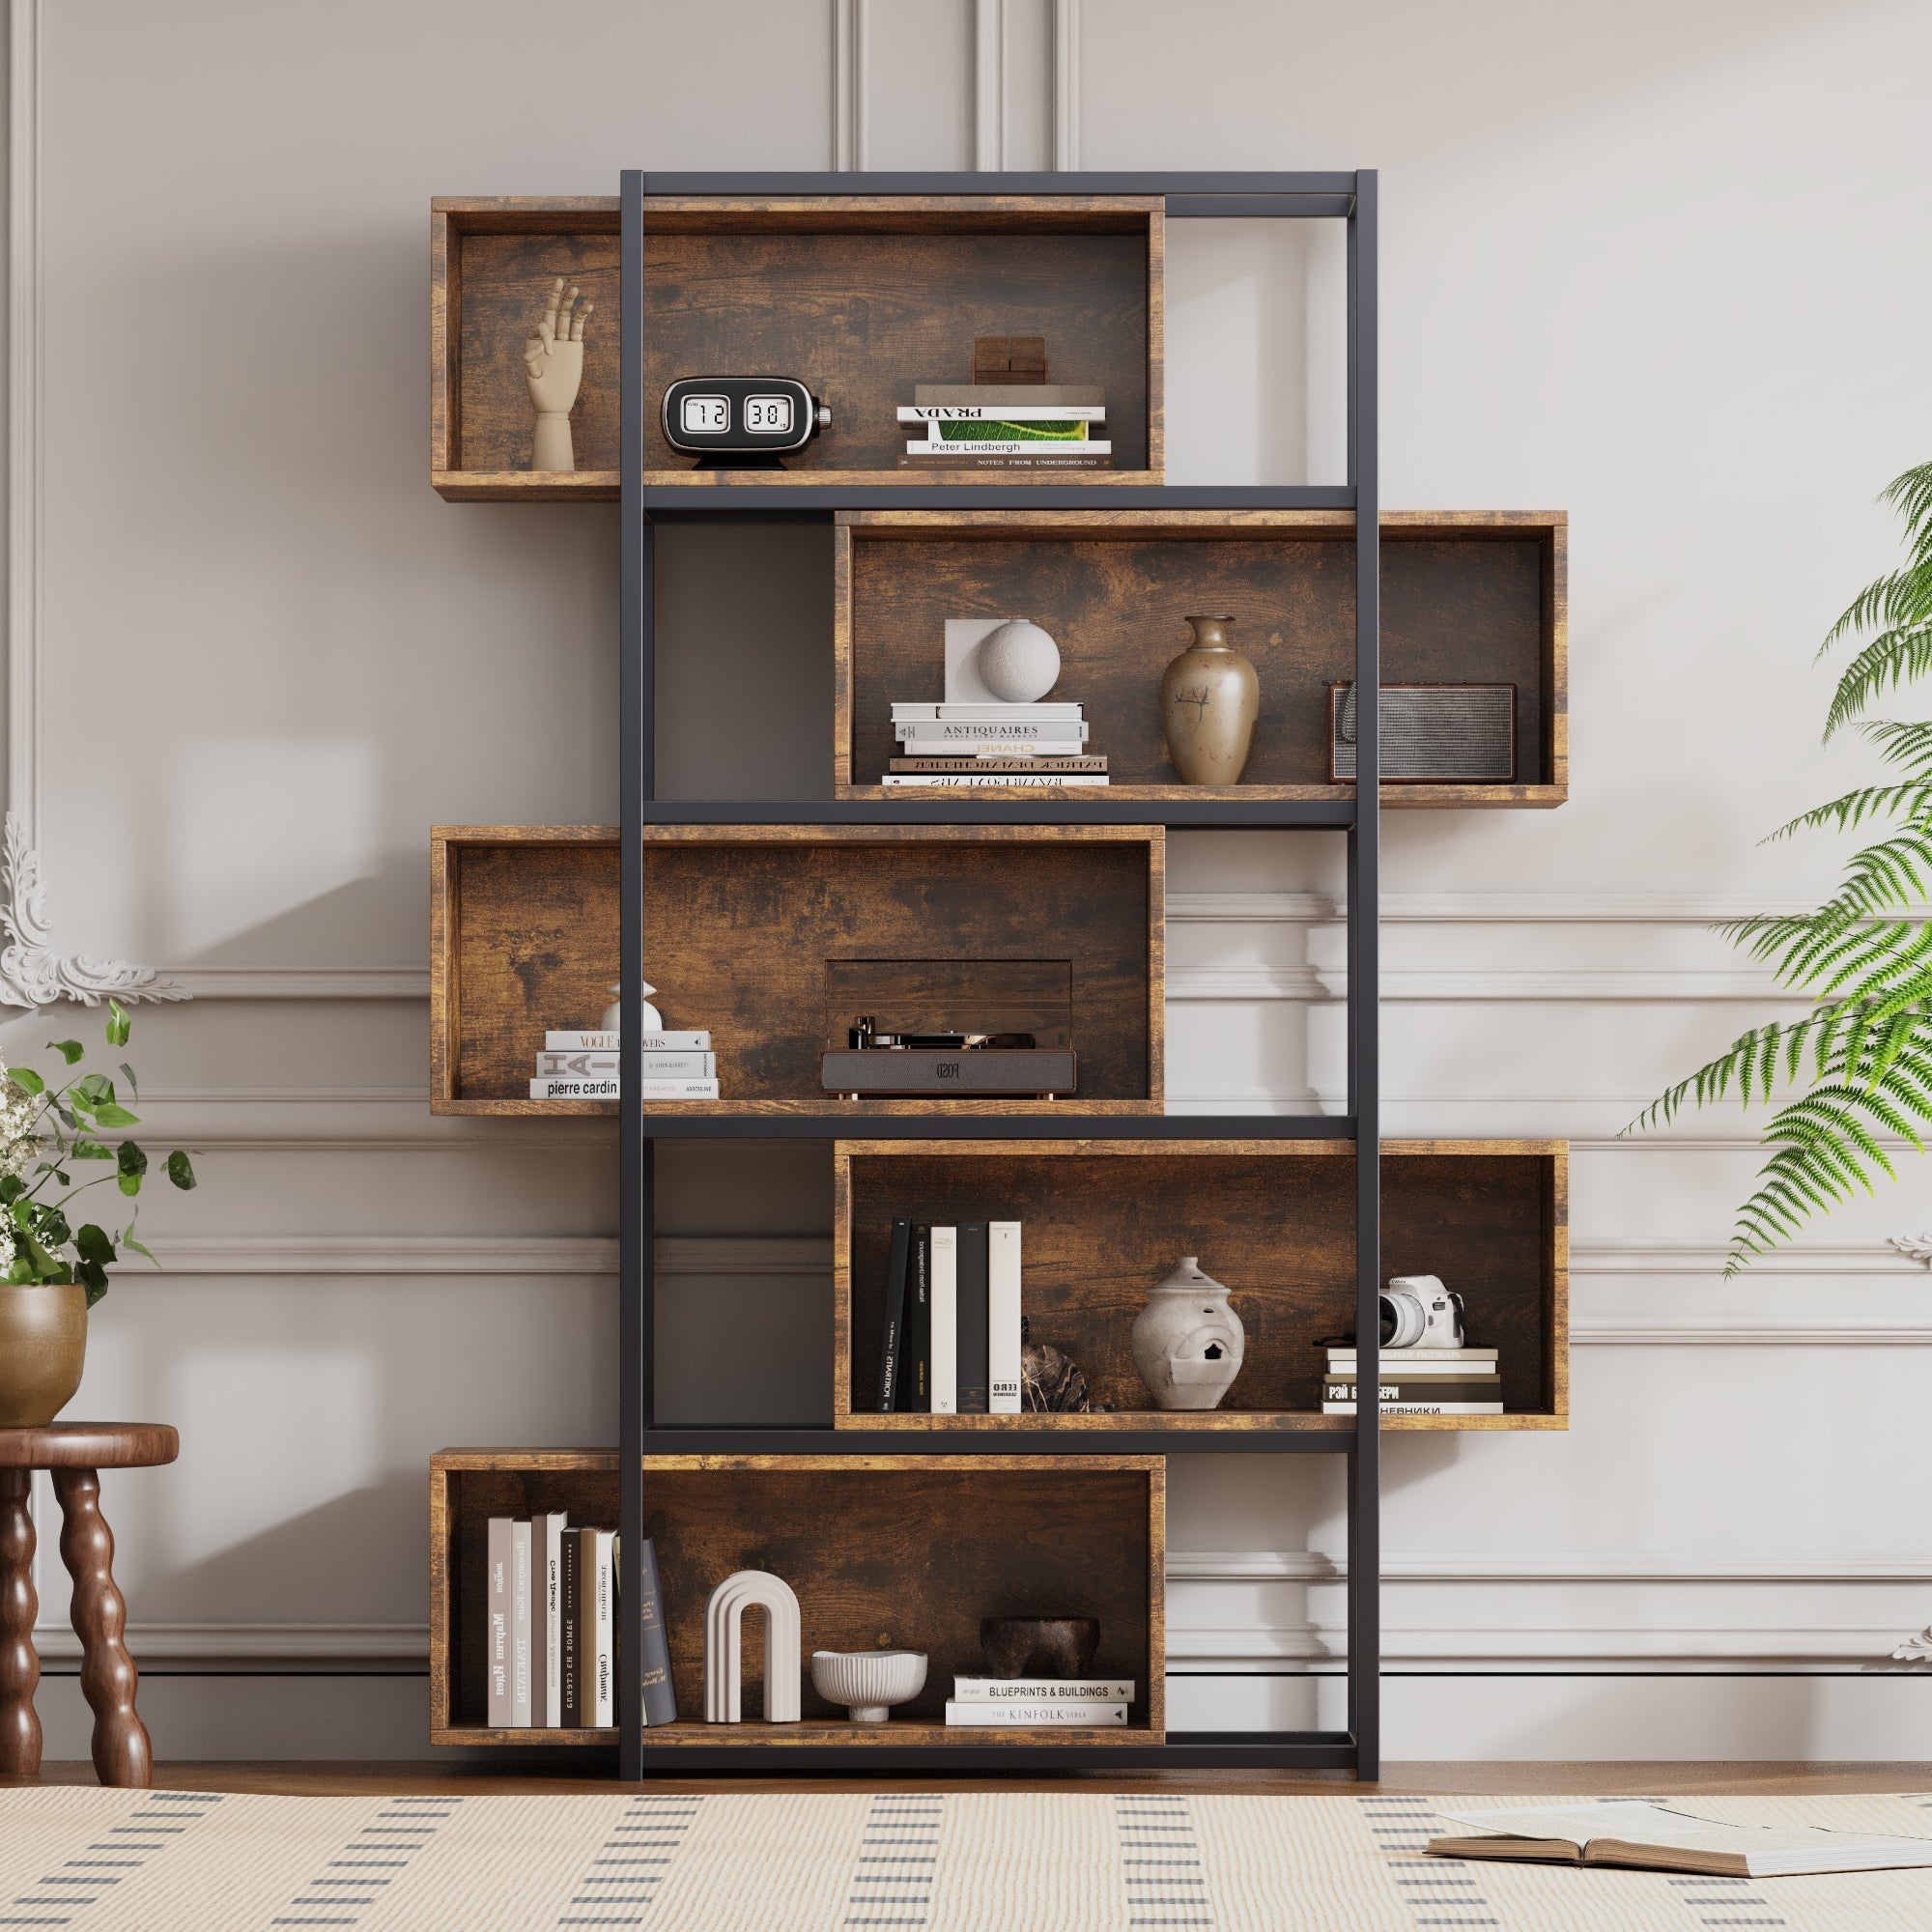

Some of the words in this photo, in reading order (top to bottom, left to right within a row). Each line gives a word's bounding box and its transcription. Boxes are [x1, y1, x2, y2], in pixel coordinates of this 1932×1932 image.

[752, 405, 778, 424] 30
[914, 408, 982, 418] PRADA
[931, 442, 960, 451] Peter
[964, 442, 1020, 452] Lindbergh
[944, 725, 1038, 735] ANTIQUAIRES
[581, 1035, 613, 1048] VOGUE
[548, 1080, 580, 1096] pierre
[582, 1080, 617, 1094] cardin
[1328, 1383, 1349, 1400] РЭЙ
[989, 1687, 1047, 1697] BLUEPRINTS
[1049, 1687, 1056, 1697] &
[1059, 1687, 1109, 1697] BUILDINGS
[1009, 1709, 1065, 1719] KINFOLK
